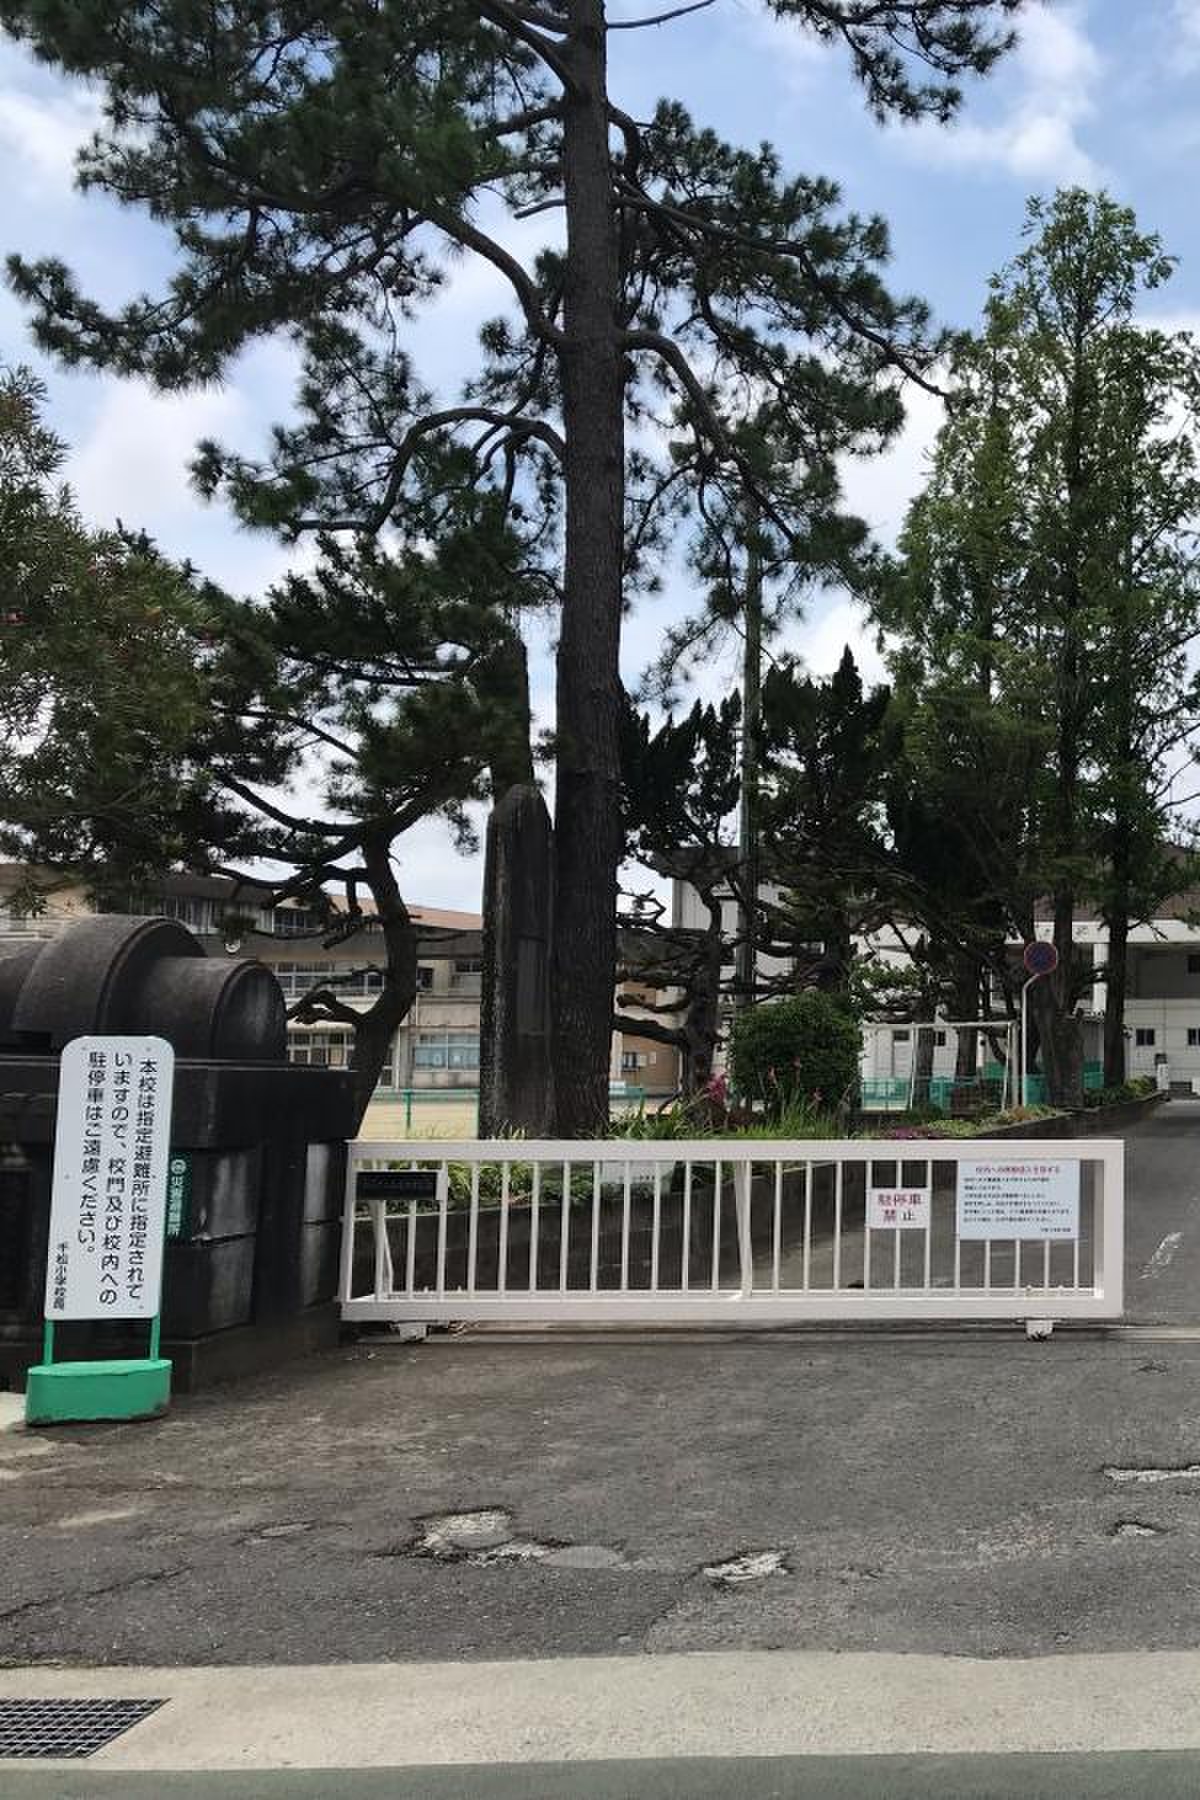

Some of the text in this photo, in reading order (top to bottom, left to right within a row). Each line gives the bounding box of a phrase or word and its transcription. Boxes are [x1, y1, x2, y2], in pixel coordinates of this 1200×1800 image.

[78, 1051, 107, 1253] 駐停車はご遠慮ください。
[99, 1052, 132, 1305] いますので、校門及び校内への
[126, 1058, 158, 1299] 本校は指定避難所に指定されて
[878, 1193, 922, 1207] 駐停車
[883, 1208, 917, 1224] 禁止
